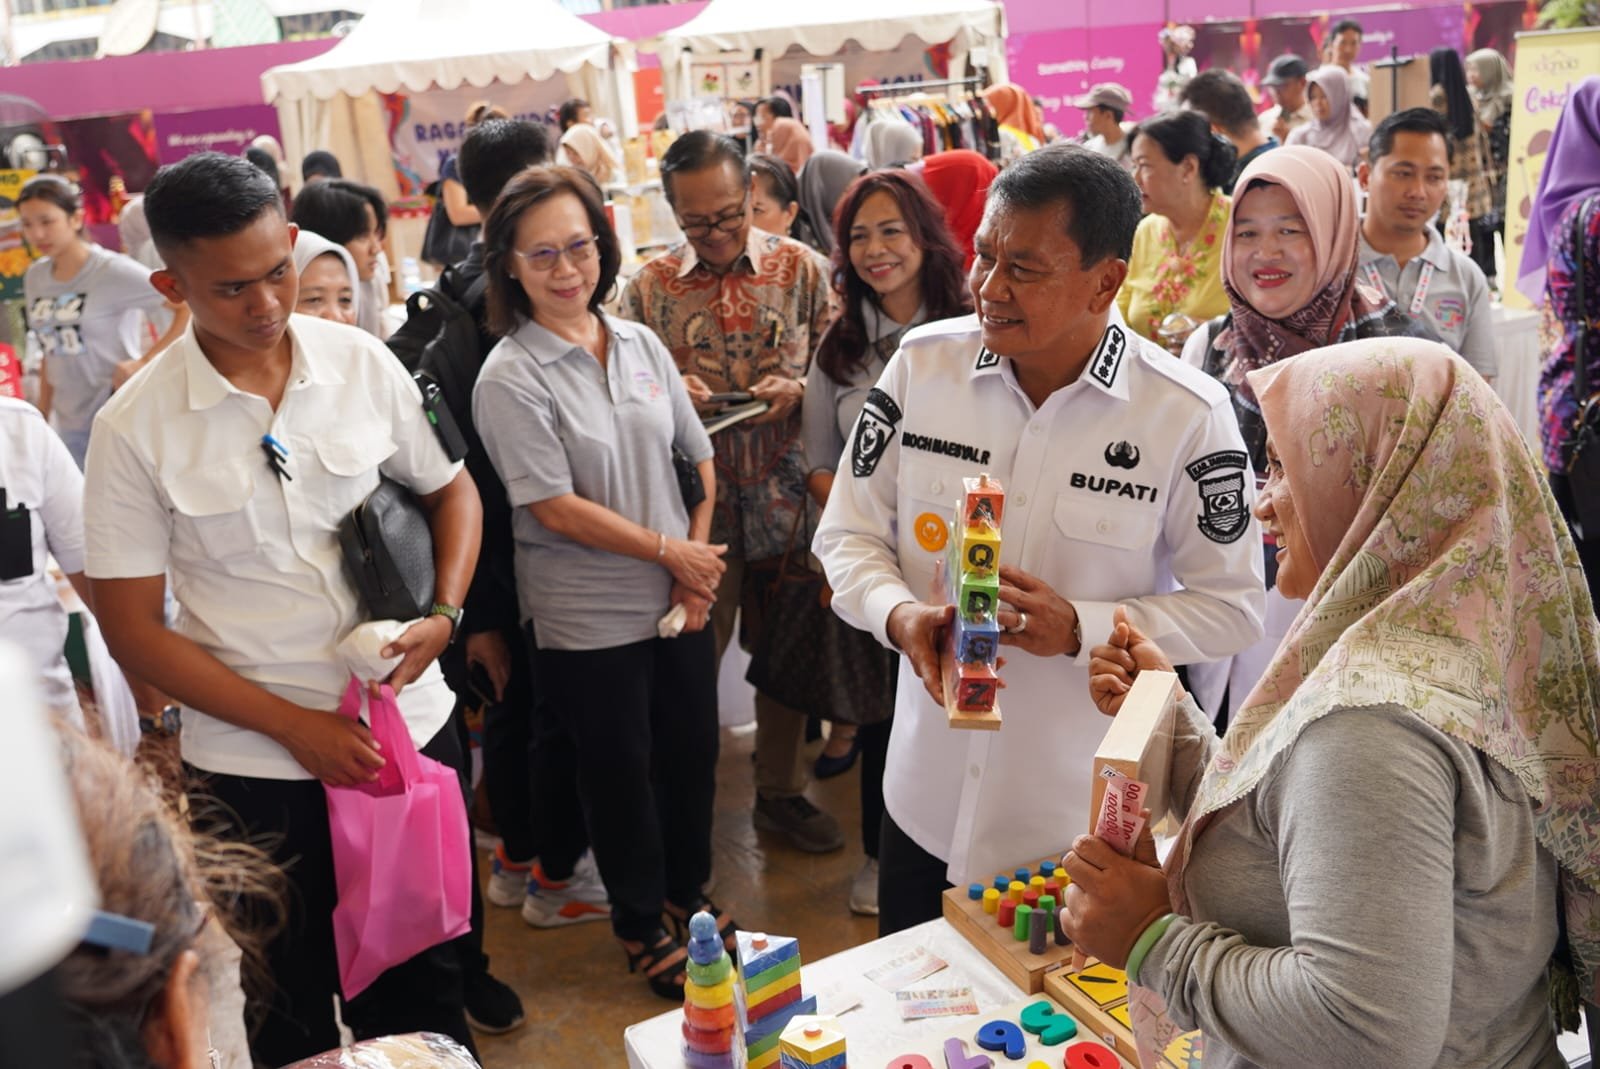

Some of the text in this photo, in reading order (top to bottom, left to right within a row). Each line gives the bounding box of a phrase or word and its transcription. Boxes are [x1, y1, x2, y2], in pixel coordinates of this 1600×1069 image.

[1070, 472, 1158, 503] BUPATI
[970, 497, 996, 522] A
[967, 543, 995, 570] Q
[967, 591, 992, 614] D
[963, 683, 990, 706] Z
[1106, 791, 1120, 836] 100000
